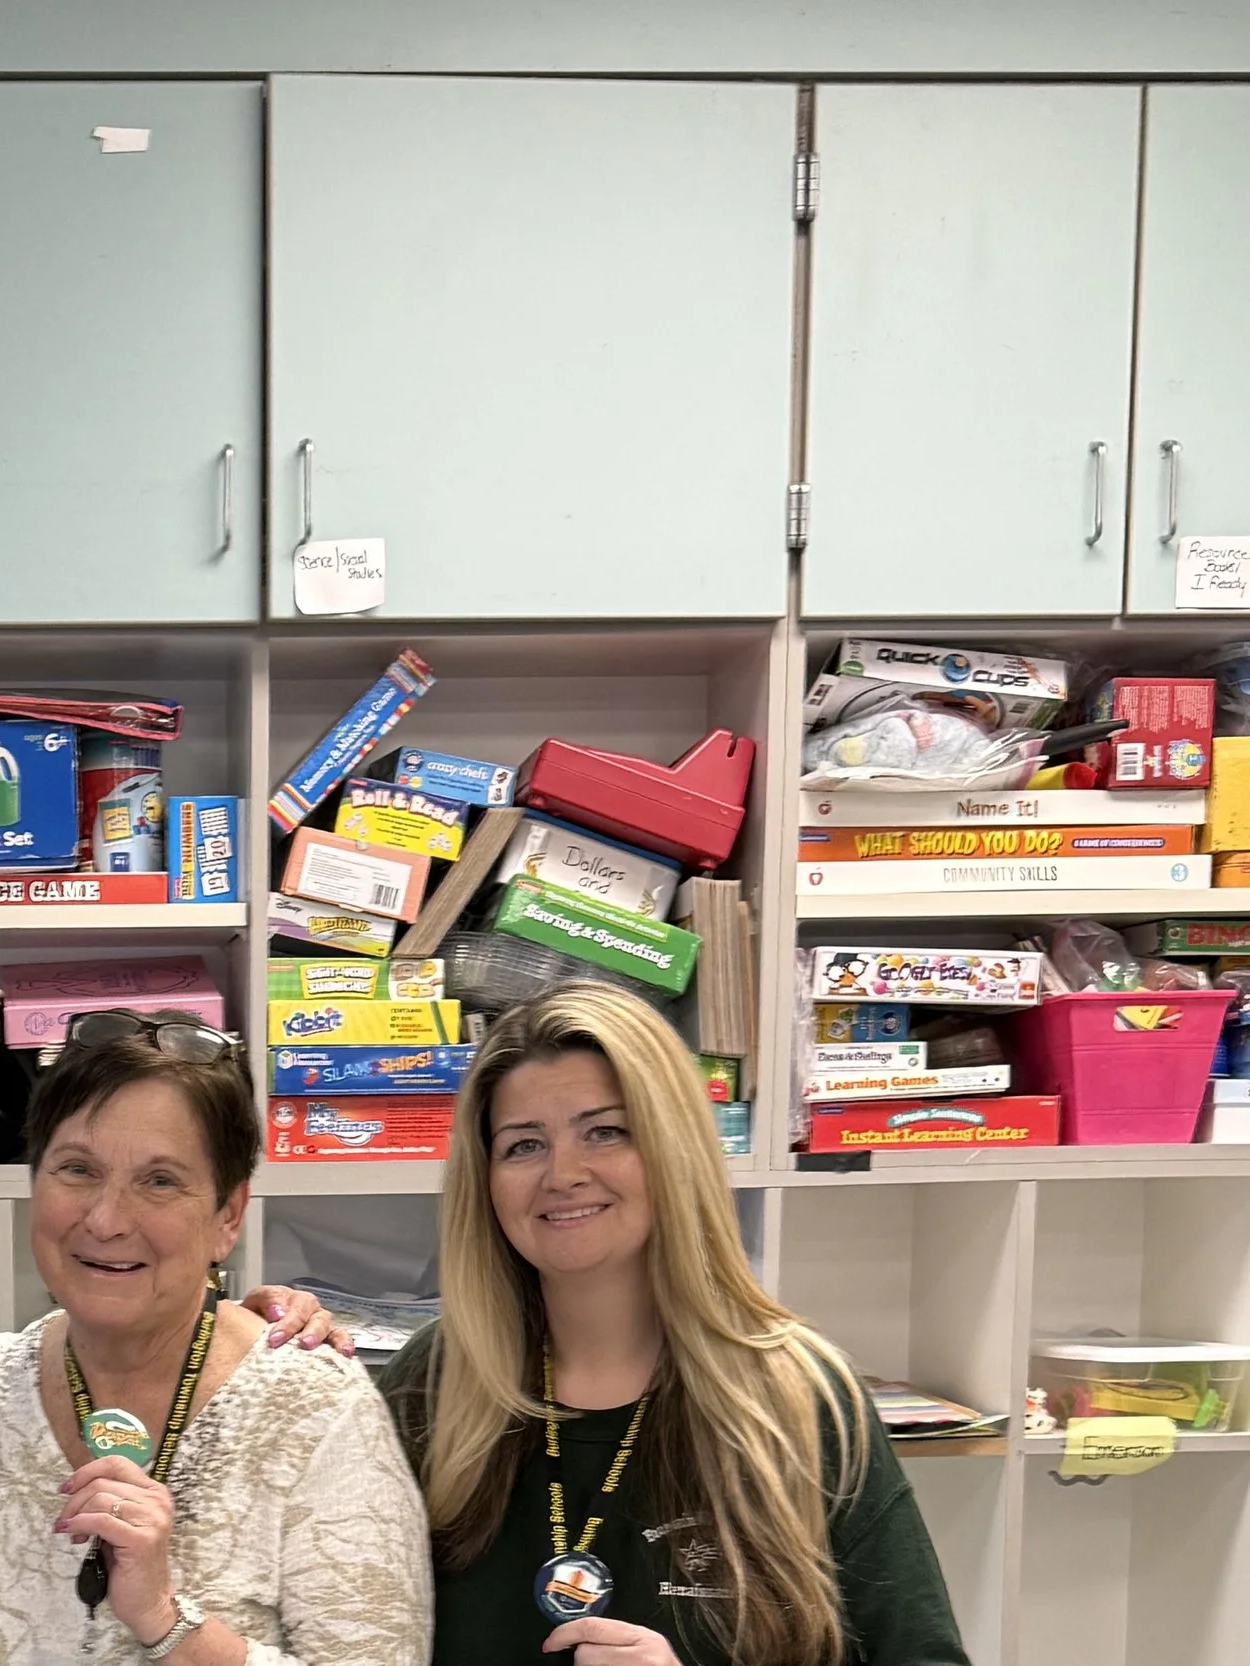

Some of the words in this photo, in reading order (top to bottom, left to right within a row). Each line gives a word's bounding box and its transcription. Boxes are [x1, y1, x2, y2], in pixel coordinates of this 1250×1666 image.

[876, 649, 941, 666] QUICK
[972, 671, 1030, 688] CUPS
[351, 788, 390, 809] Roll
[392, 791, 410, 810] &
[408, 795, 460, 827] Read
[956, 799, 1009, 818] Name
[1016, 799, 1039, 818] It!
[3, 831, 35, 847] Set
[854, 831, 905, 859] WHAT
[908, 831, 978, 856] SHOULD
[981, 831, 1018, 856] YOU
[1023, 831, 1063, 856] DO?
[562, 845, 627, 881] Dollars
[943, 867, 1015, 884] COMMUNITY
[1019, 865, 1058, 882] SKILLS
[28, 880, 101, 902] GAME
[523, 903, 584, 938] Saving
[593, 928, 676, 970] Spending
[825, 1076, 888, 1092] Learning
[891, 1074, 939, 1087] Games
[840, 1129, 900, 1146] Instant
[902, 1127, 972, 1143] Learning
[975, 1125, 1030, 1141] Center
